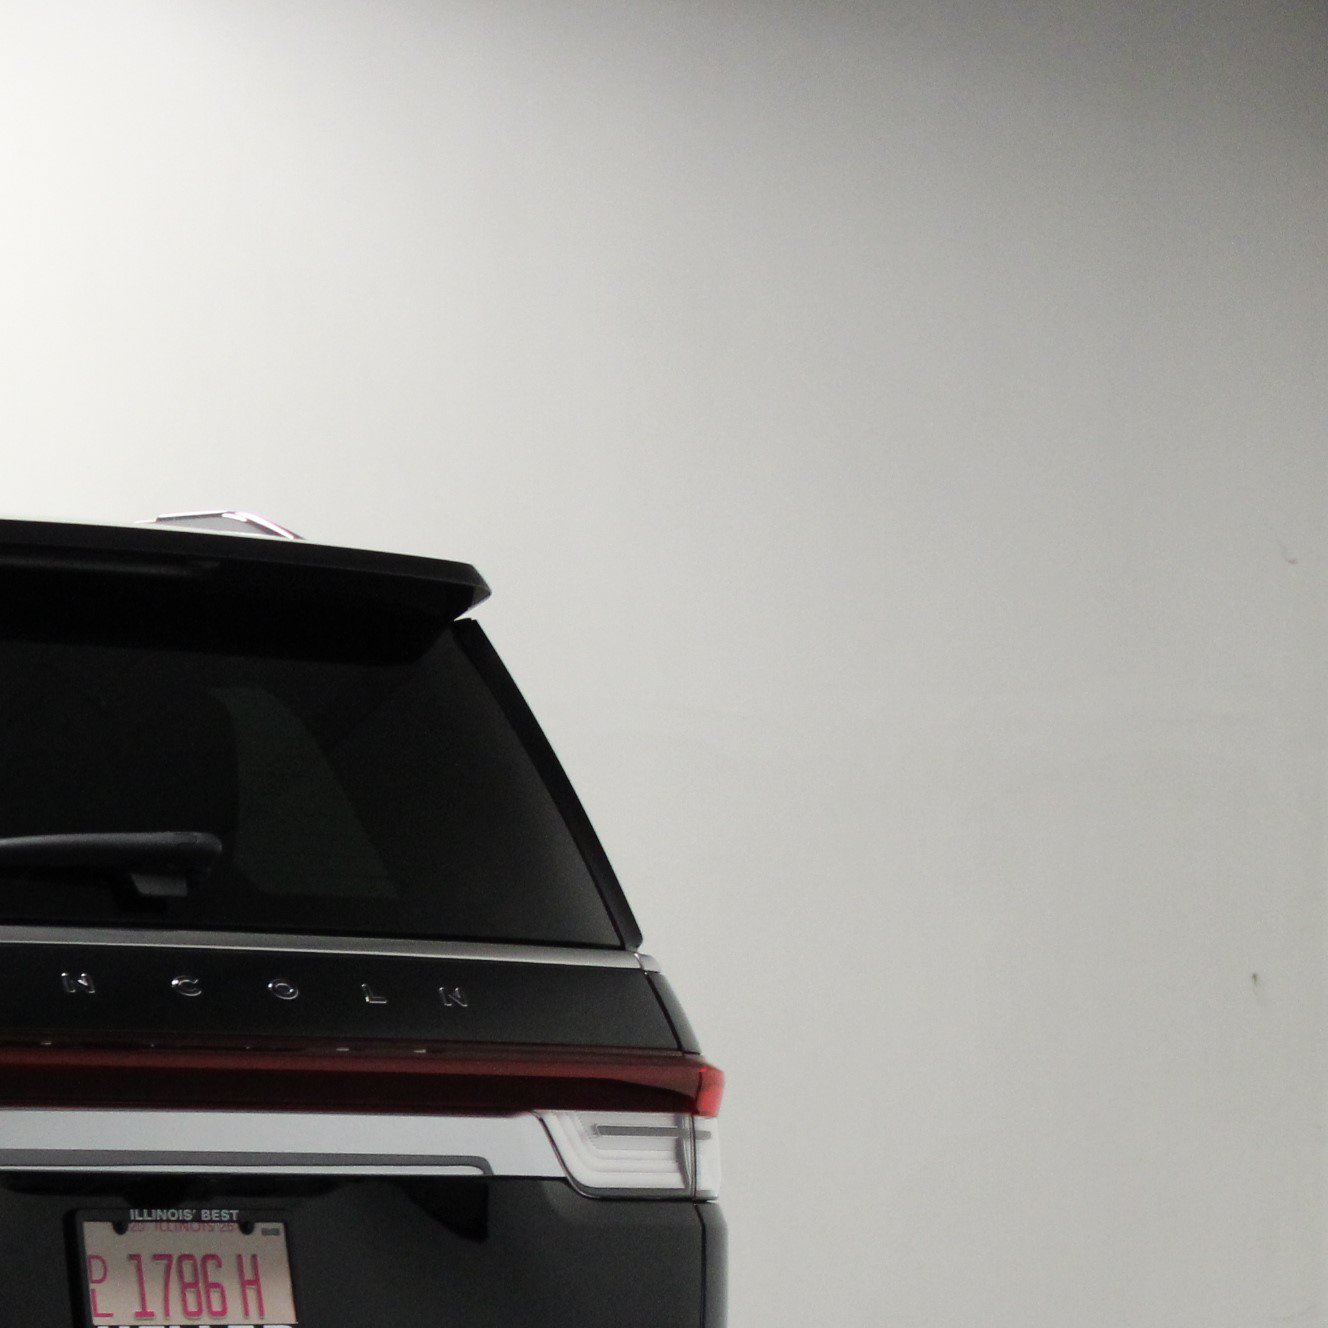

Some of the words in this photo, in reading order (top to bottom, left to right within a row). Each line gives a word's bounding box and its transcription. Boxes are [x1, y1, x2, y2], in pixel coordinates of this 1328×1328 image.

[129, 1209, 196, 1221] ILLINOIS'
[201, 1209, 239, 1221] BEST
[127, 1253, 230, 1321] 1786
